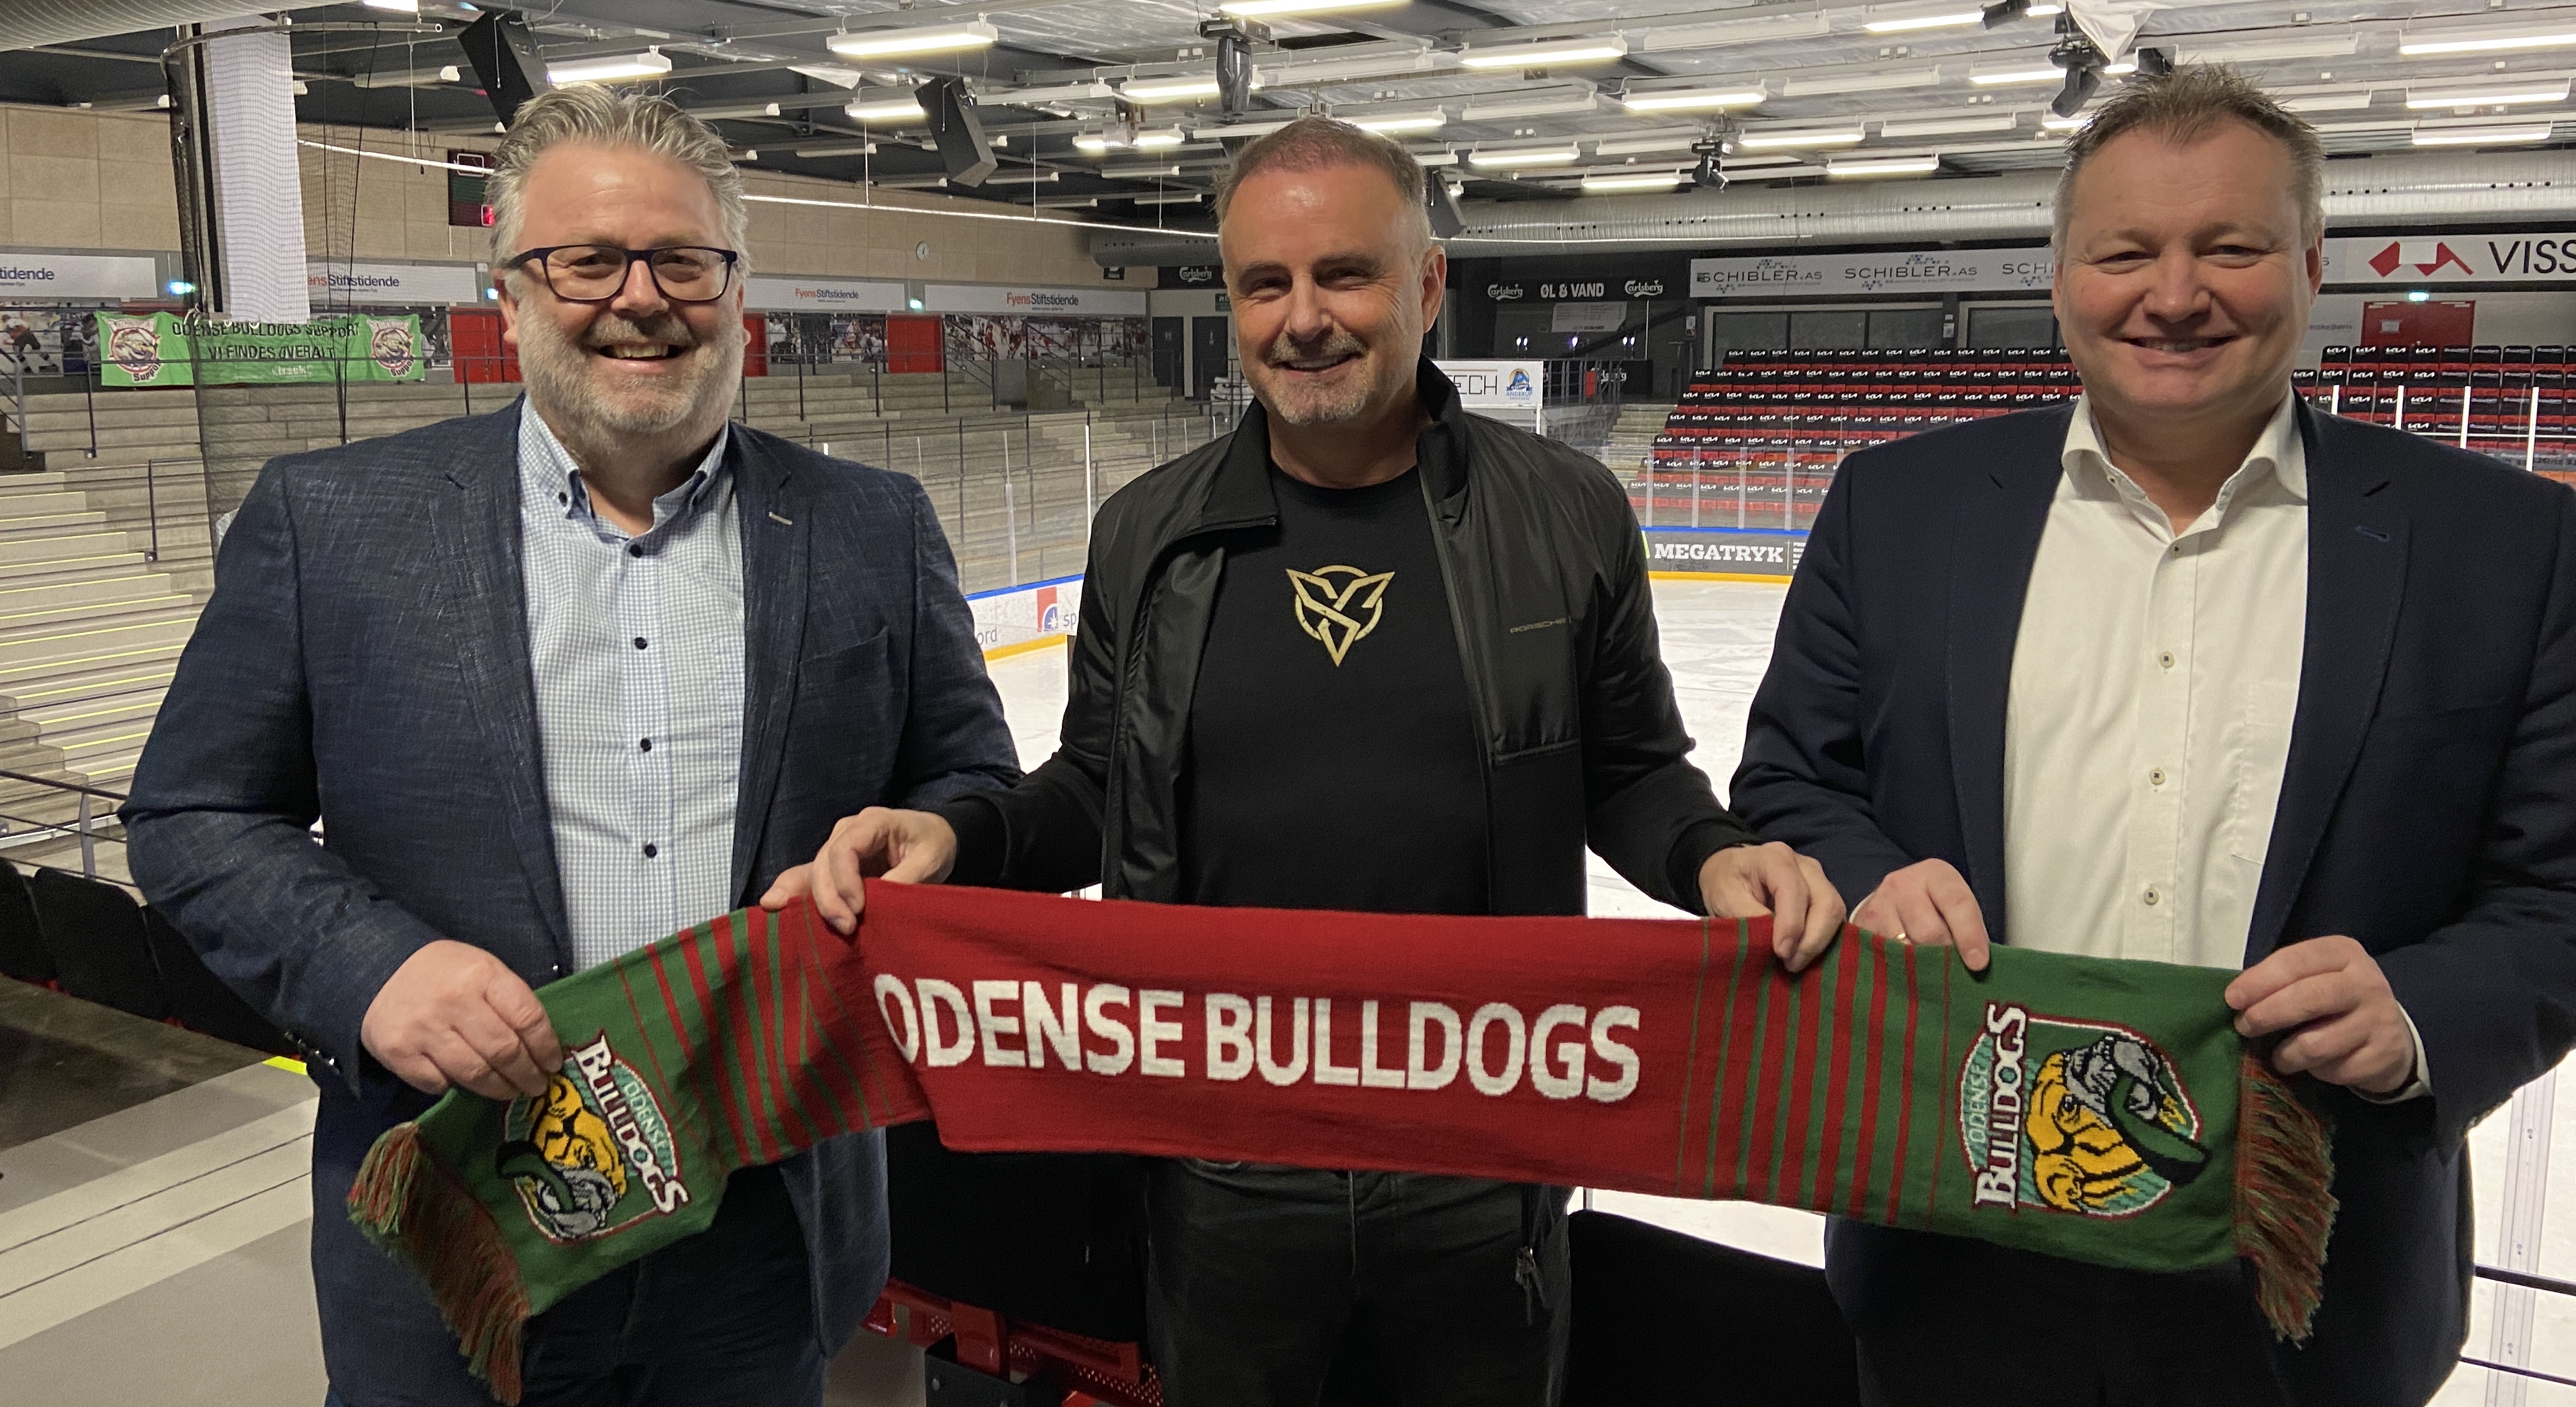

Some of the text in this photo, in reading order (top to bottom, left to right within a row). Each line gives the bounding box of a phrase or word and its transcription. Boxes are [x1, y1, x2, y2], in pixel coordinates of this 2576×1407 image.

[2488, 240, 2576, 274] VISS
[1179, 266, 1212, 282] Carlsberg
[1844, 266, 1977, 279] SCHIBLER.AS
[1487, 284, 1523, 300] Carlsberg
[1540, 282, 1604, 298] ØL & VAND
[1625, 280, 1663, 297] Carlsberg
[172, 322, 229, 337] ODENSE
[231, 321, 302, 336] BULLDOGS
[305, 322, 359, 337] SUPPORT
[208, 346, 223, 359] VI
[226, 344, 275, 359] FINDES
[1446, 374, 1498, 395] ECH
[1654, 542, 1784, 563] MEGATRYK
[873, 973, 1641, 1103] ODENSE BULLDOGS
[623, 1080, 669, 1148] ODENSE
[1967, 1065, 1990, 1144] ODENSE
[1975, 1003, 2027, 1210] BULLDOGS
[572, 1033, 689, 1213] BULLDOGS
